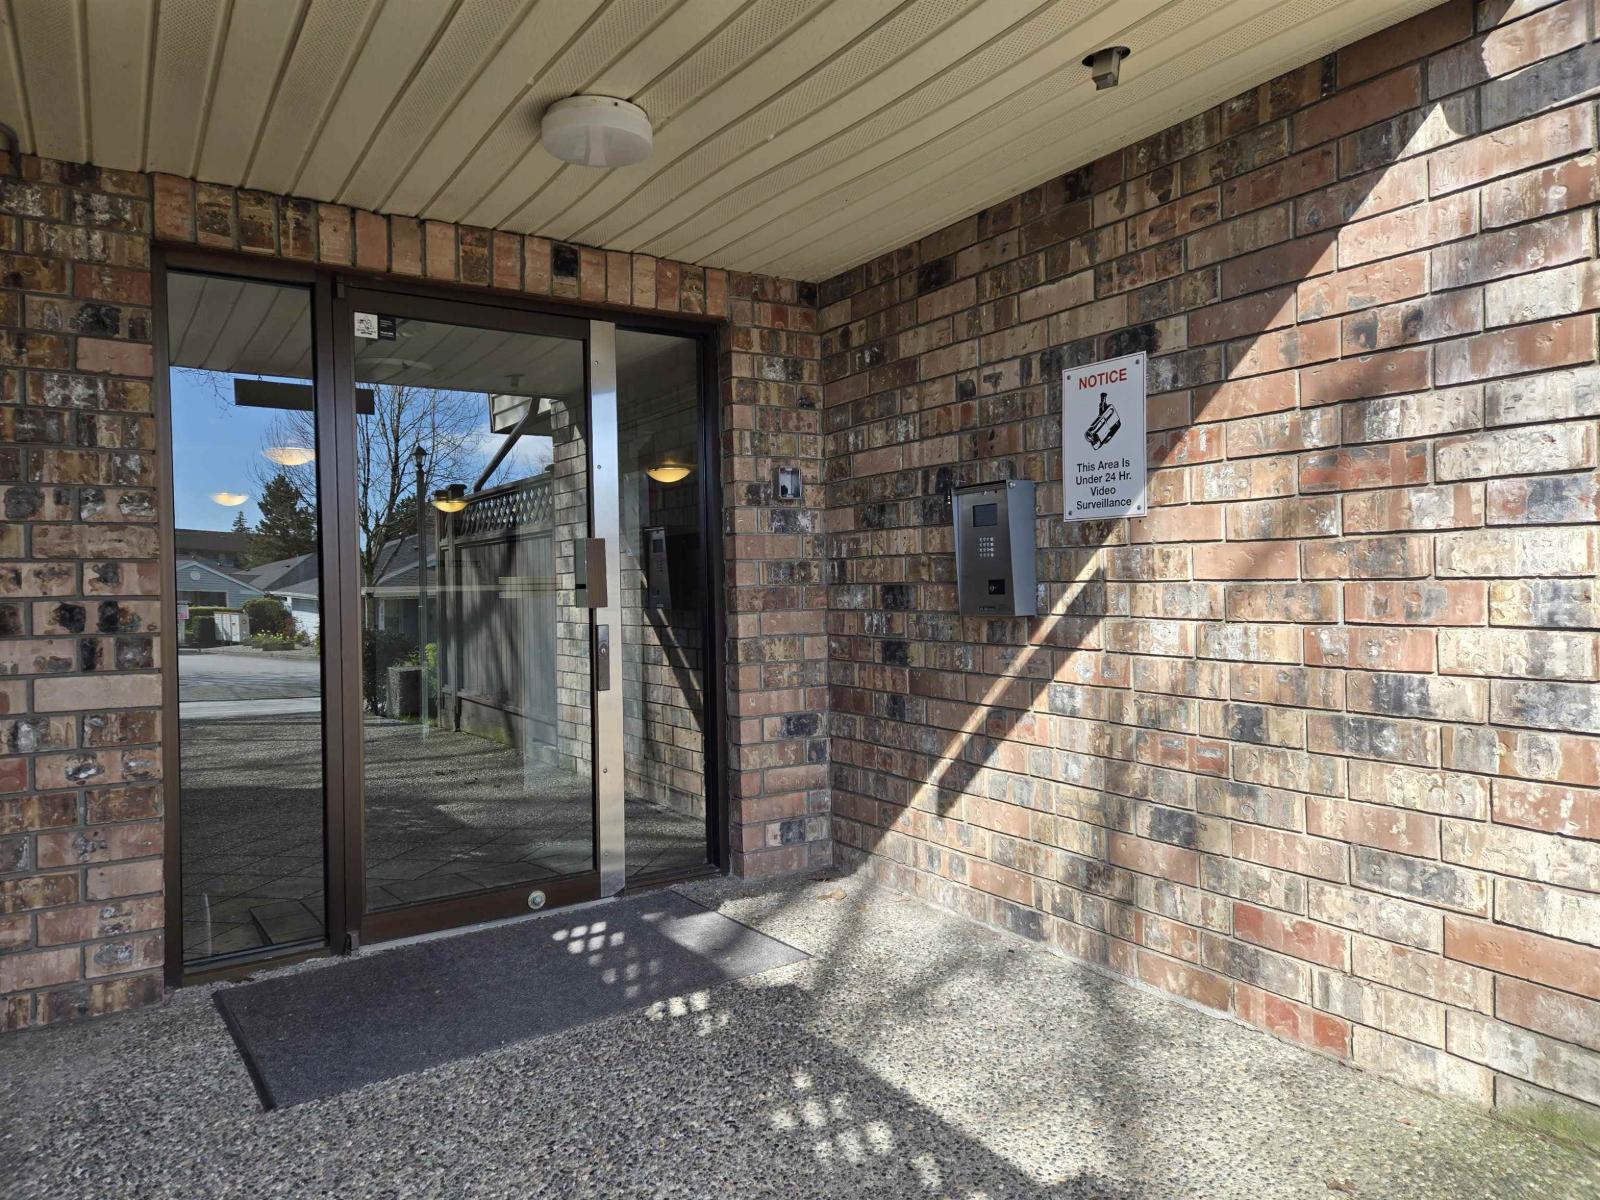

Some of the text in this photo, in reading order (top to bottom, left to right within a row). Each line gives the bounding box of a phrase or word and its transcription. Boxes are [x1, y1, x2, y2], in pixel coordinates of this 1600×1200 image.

[1079, 368, 1127, 390] NOTICE
[1077, 458, 1130, 473] This Area Is
[1076, 471, 1132, 485] Under 24 Hr.
[1090, 486, 1116, 496] Video
[1076, 498, 1132, 510] Surveillance
